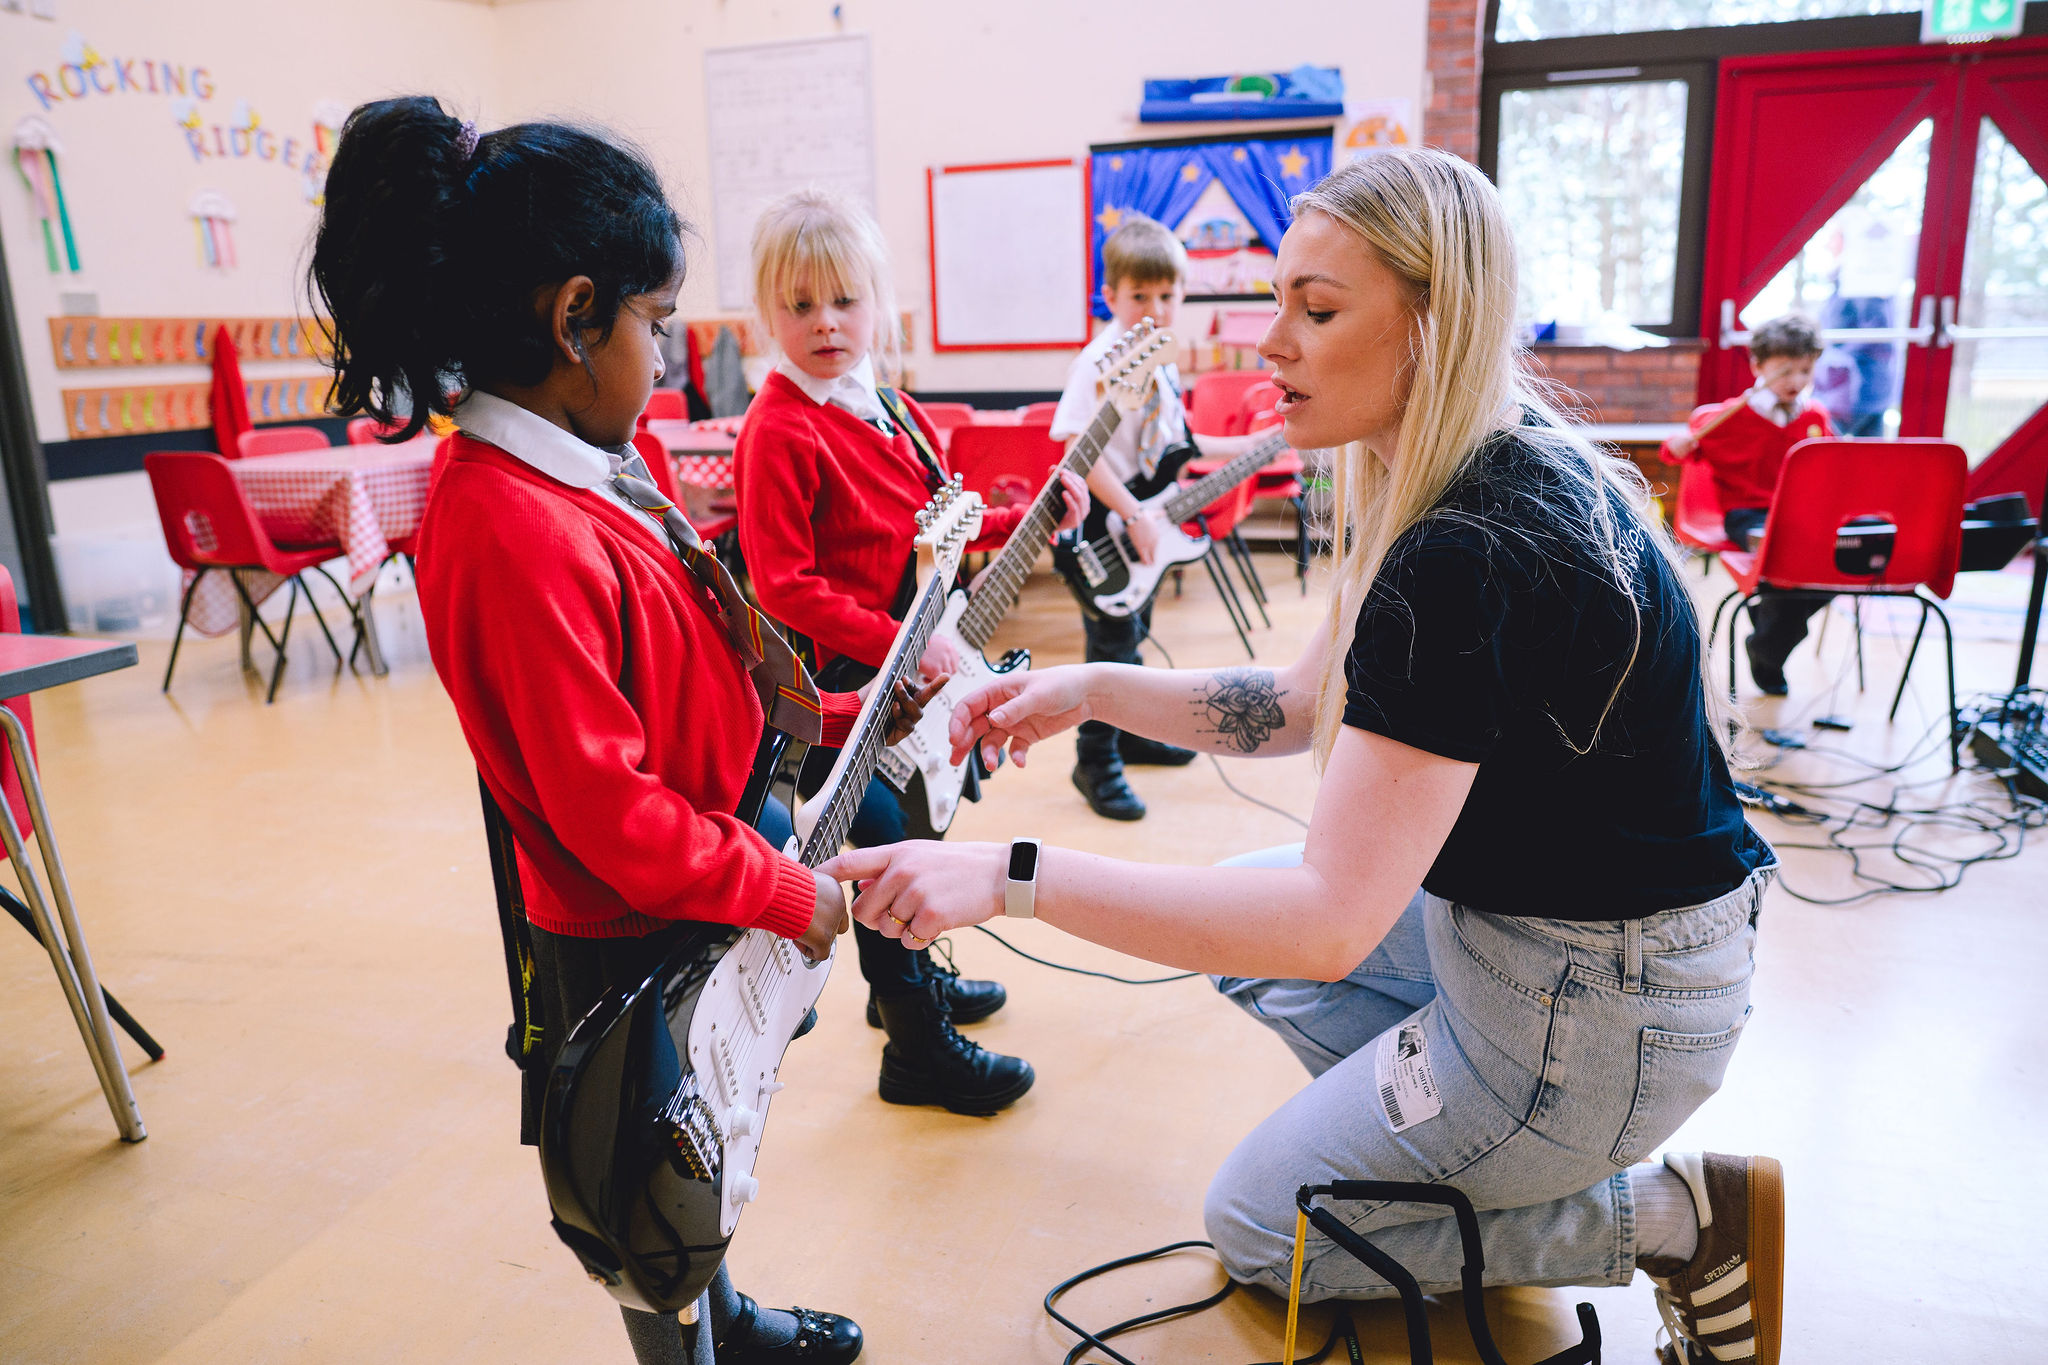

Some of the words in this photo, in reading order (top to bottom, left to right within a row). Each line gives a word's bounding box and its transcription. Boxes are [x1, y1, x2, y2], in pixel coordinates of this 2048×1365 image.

[27, 57, 215, 110] ROCKING
[1418, 1066, 1432, 1099] VISITOR
[1704, 1260, 1735, 1283] SPEZIAL
